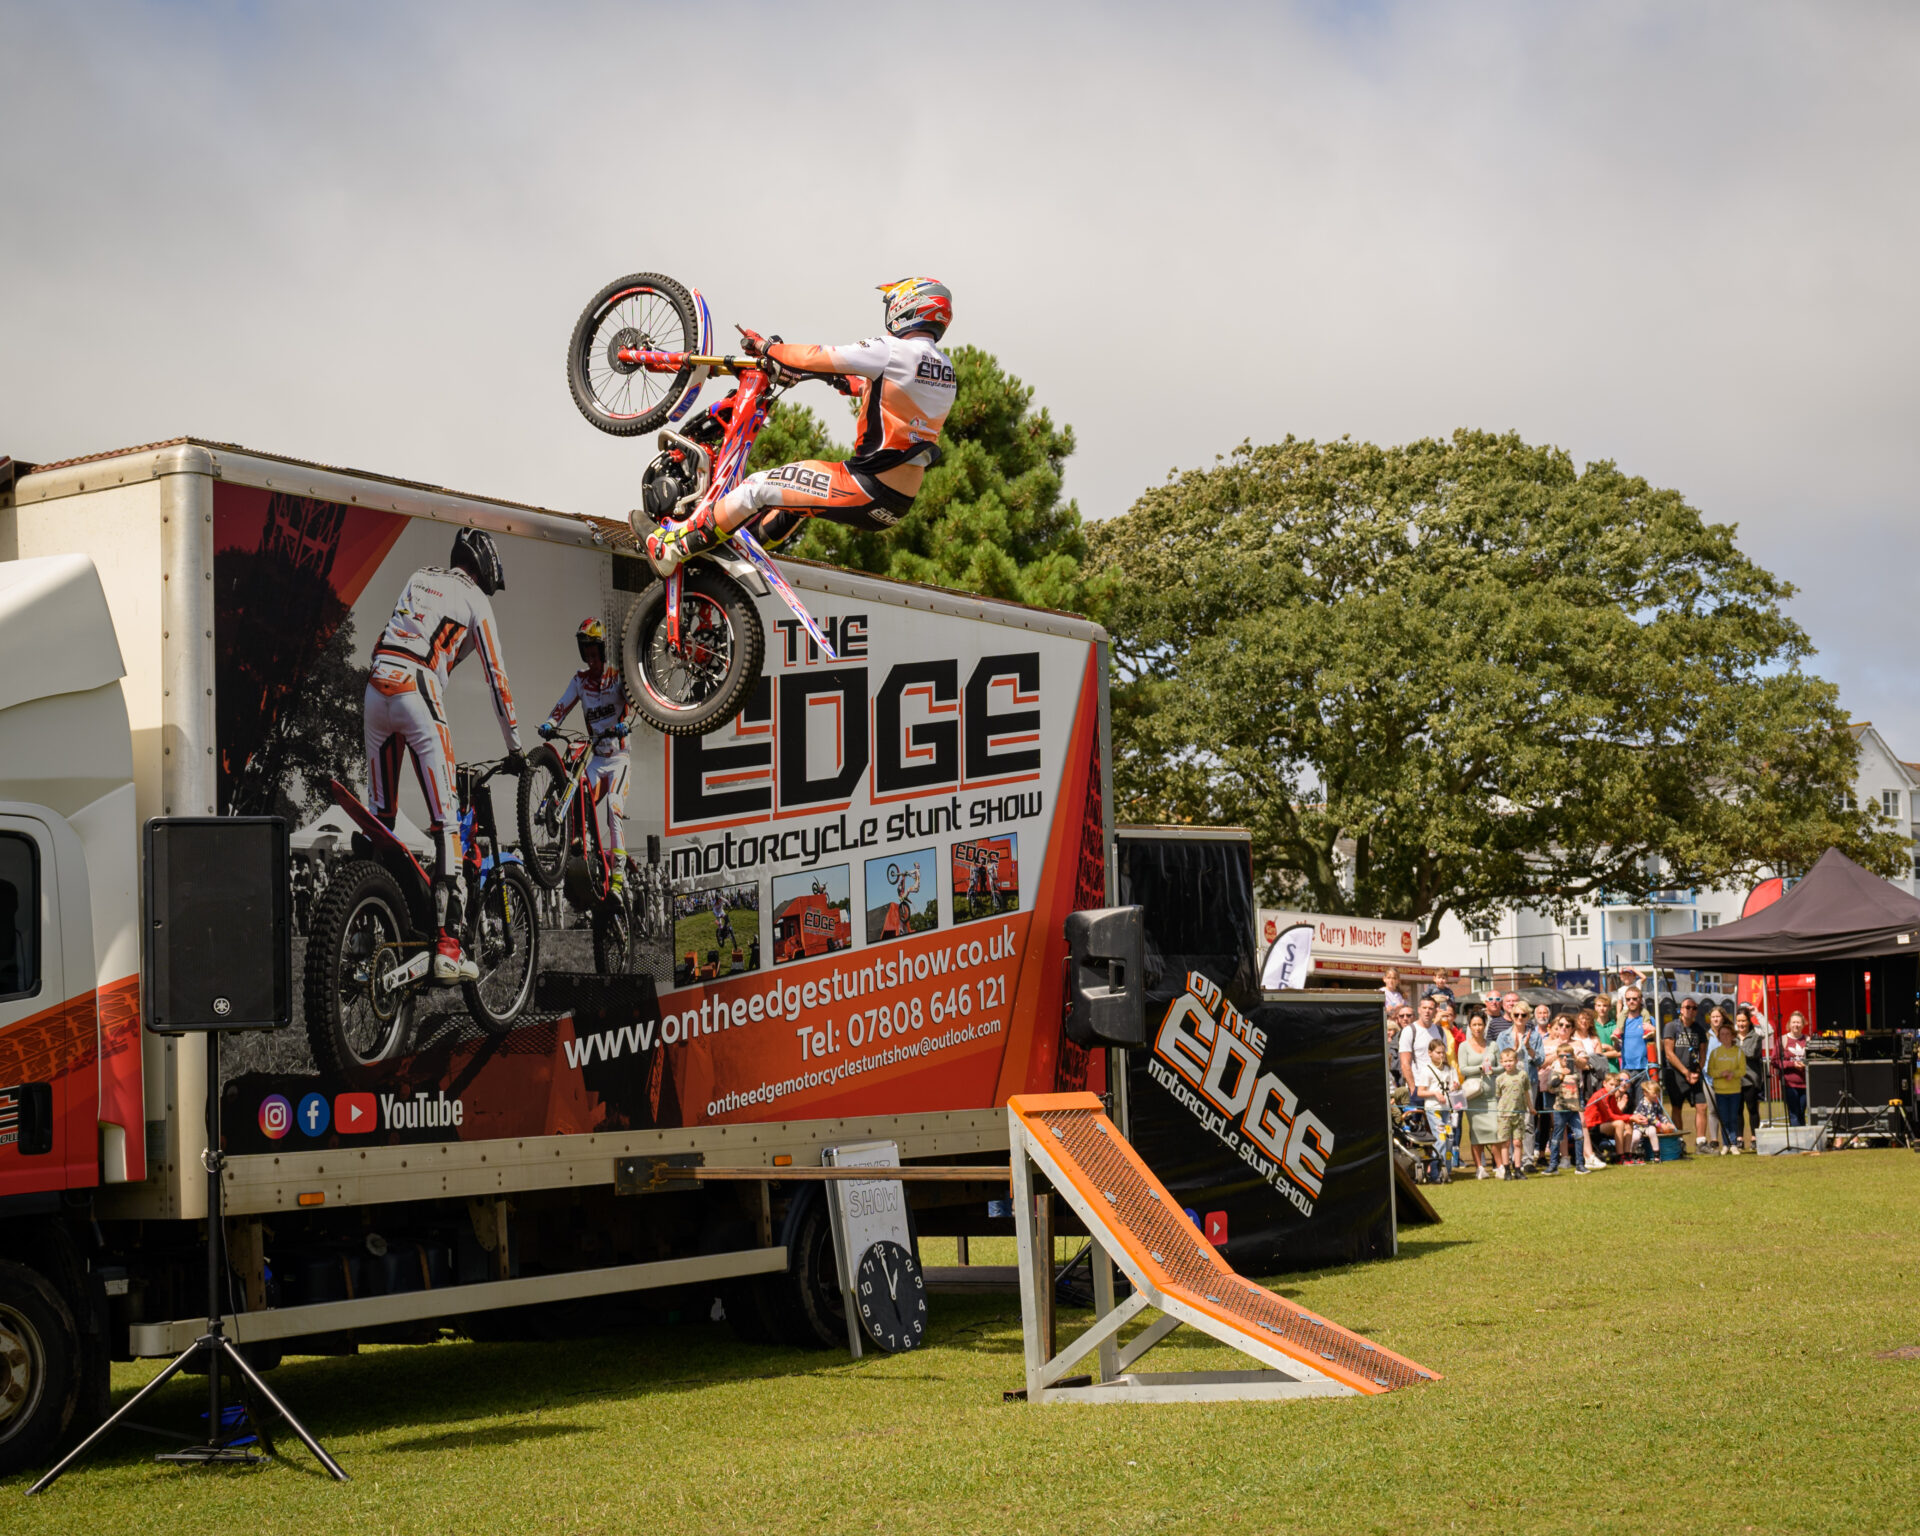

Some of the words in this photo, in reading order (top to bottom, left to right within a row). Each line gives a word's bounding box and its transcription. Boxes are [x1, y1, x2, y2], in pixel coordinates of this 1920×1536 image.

[767, 466, 831, 491] EDGE
[867, 508, 899, 525] EDG
[774, 614, 869, 667] THE
[665, 652, 1041, 837] EDGE
[886, 796, 962, 843] stunt
[955, 844, 1000, 866] EDGE
[804, 912, 835, 932] EDGE
[1319, 922, 1346, 947] Curry
[1349, 925, 1387, 948] Monster
[563, 925, 1017, 1069] www.ontheedgestuntshow.co.uk
[796, 1020, 841, 1061] Tel:
[847, 997, 925, 1048] 07808
[929, 983, 973, 1025] 646
[976, 974, 1007, 1011] 121
[1220, 999, 1268, 1060] THE
[706, 1018, 1002, 1117] ontheedgemotorcyclestuntshow@outlook.com
[1154, 992, 1335, 1199] EDGE
[380, 1090, 464, 1130] YouTube
[1238, 1143, 1279, 1186] stunt
[849, 1186, 898, 1218] SHOW
[873, 1244, 886, 1260] 12
[891, 1247, 899, 1259] 1
[863, 1260, 875, 1274] 11
[905, 1258, 914, 1272] 2
[860, 1283, 873, 1296] 10
[915, 1276, 923, 1288] 3
[862, 1304, 871, 1317] 9
[918, 1299, 926, 1311] 4
[874, 1323, 883, 1337] 8
[913, 1320, 922, 1333] 5
[888, 1334, 896, 1348] 7
[903, 1335, 912, 1348] 6
